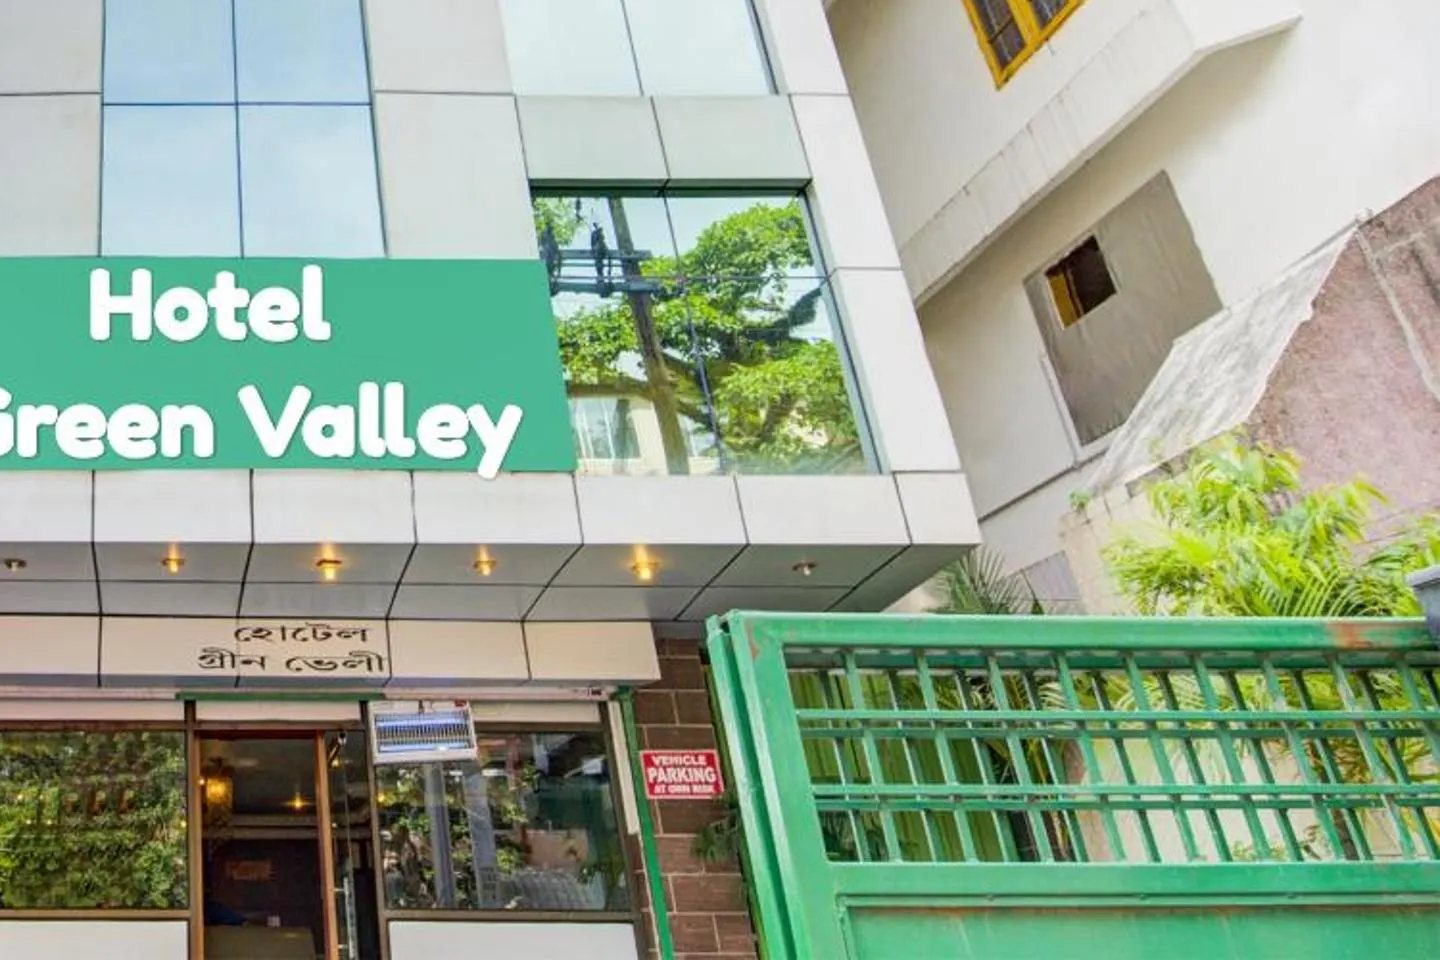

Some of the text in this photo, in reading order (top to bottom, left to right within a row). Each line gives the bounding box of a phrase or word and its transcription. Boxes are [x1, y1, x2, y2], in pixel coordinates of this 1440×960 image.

[89, 264, 332, 342] Hotel
[236, 380, 524, 480] Valley
[234, 622, 370, 642] হোটেল
[284, 649, 387, 672] ভেলী
[651, 754, 708, 766] VEHICLE
[646, 766, 717, 784] PARKING
